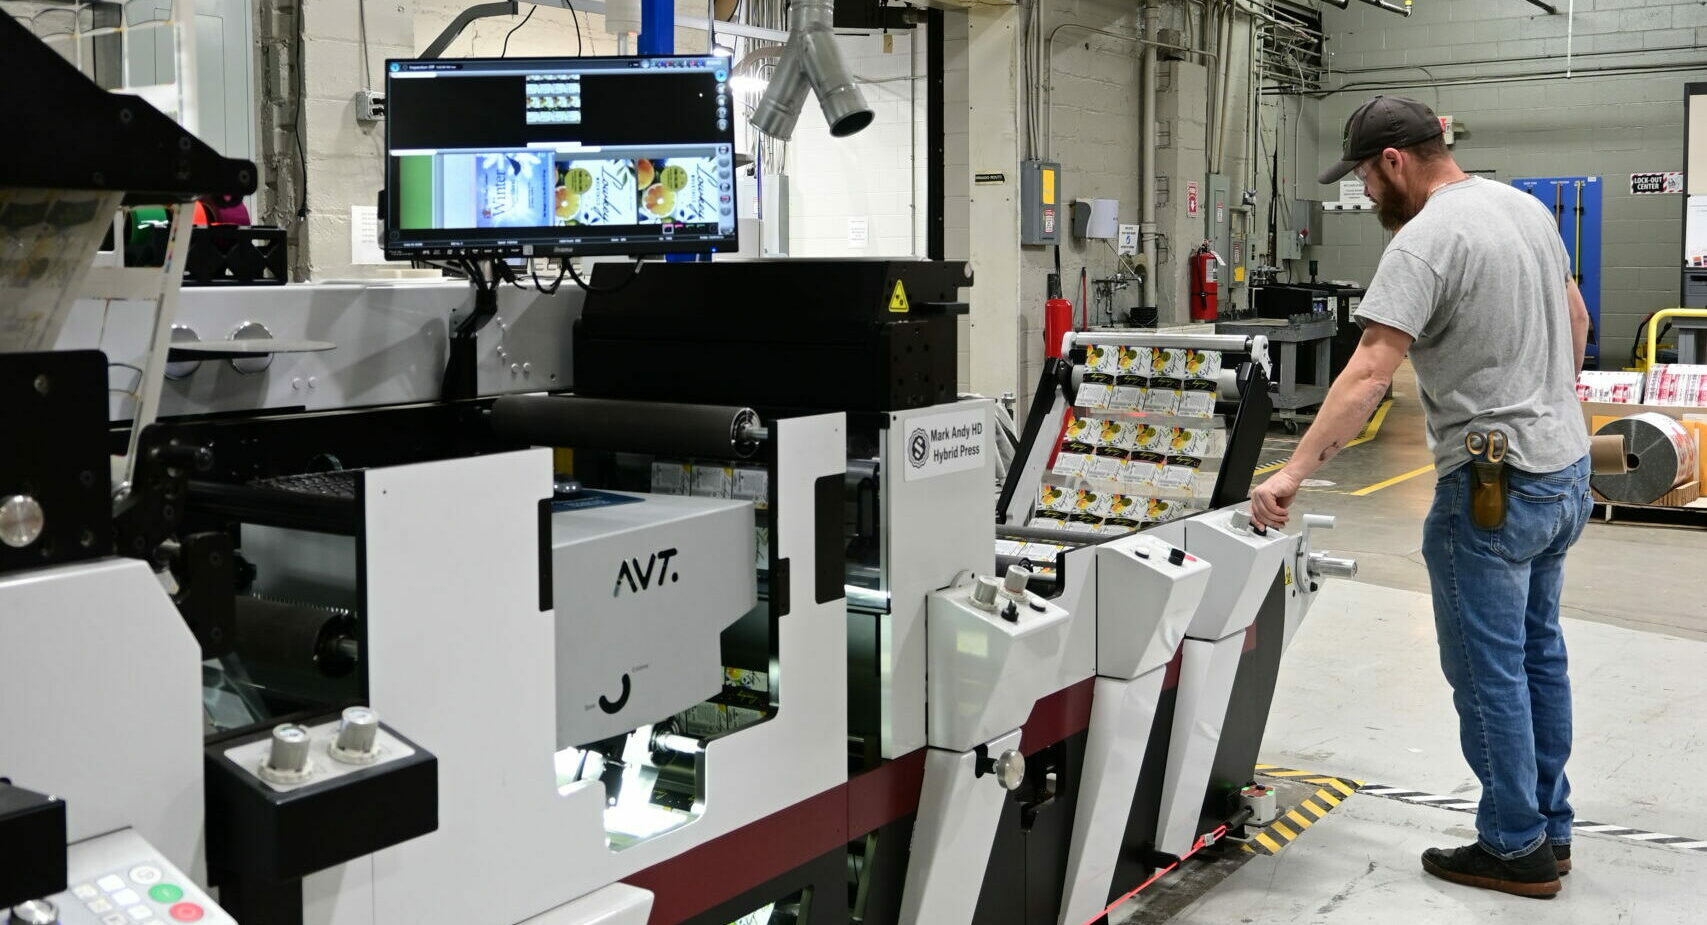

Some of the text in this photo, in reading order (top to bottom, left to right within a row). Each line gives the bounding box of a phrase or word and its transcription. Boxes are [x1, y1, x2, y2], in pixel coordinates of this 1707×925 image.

[493, 169, 505, 216] Winter
[590, 165, 623, 223] Lowkey
[930, 422, 982, 442] Mark Andy HD
[933, 445, 980, 464] Hybrid Press
